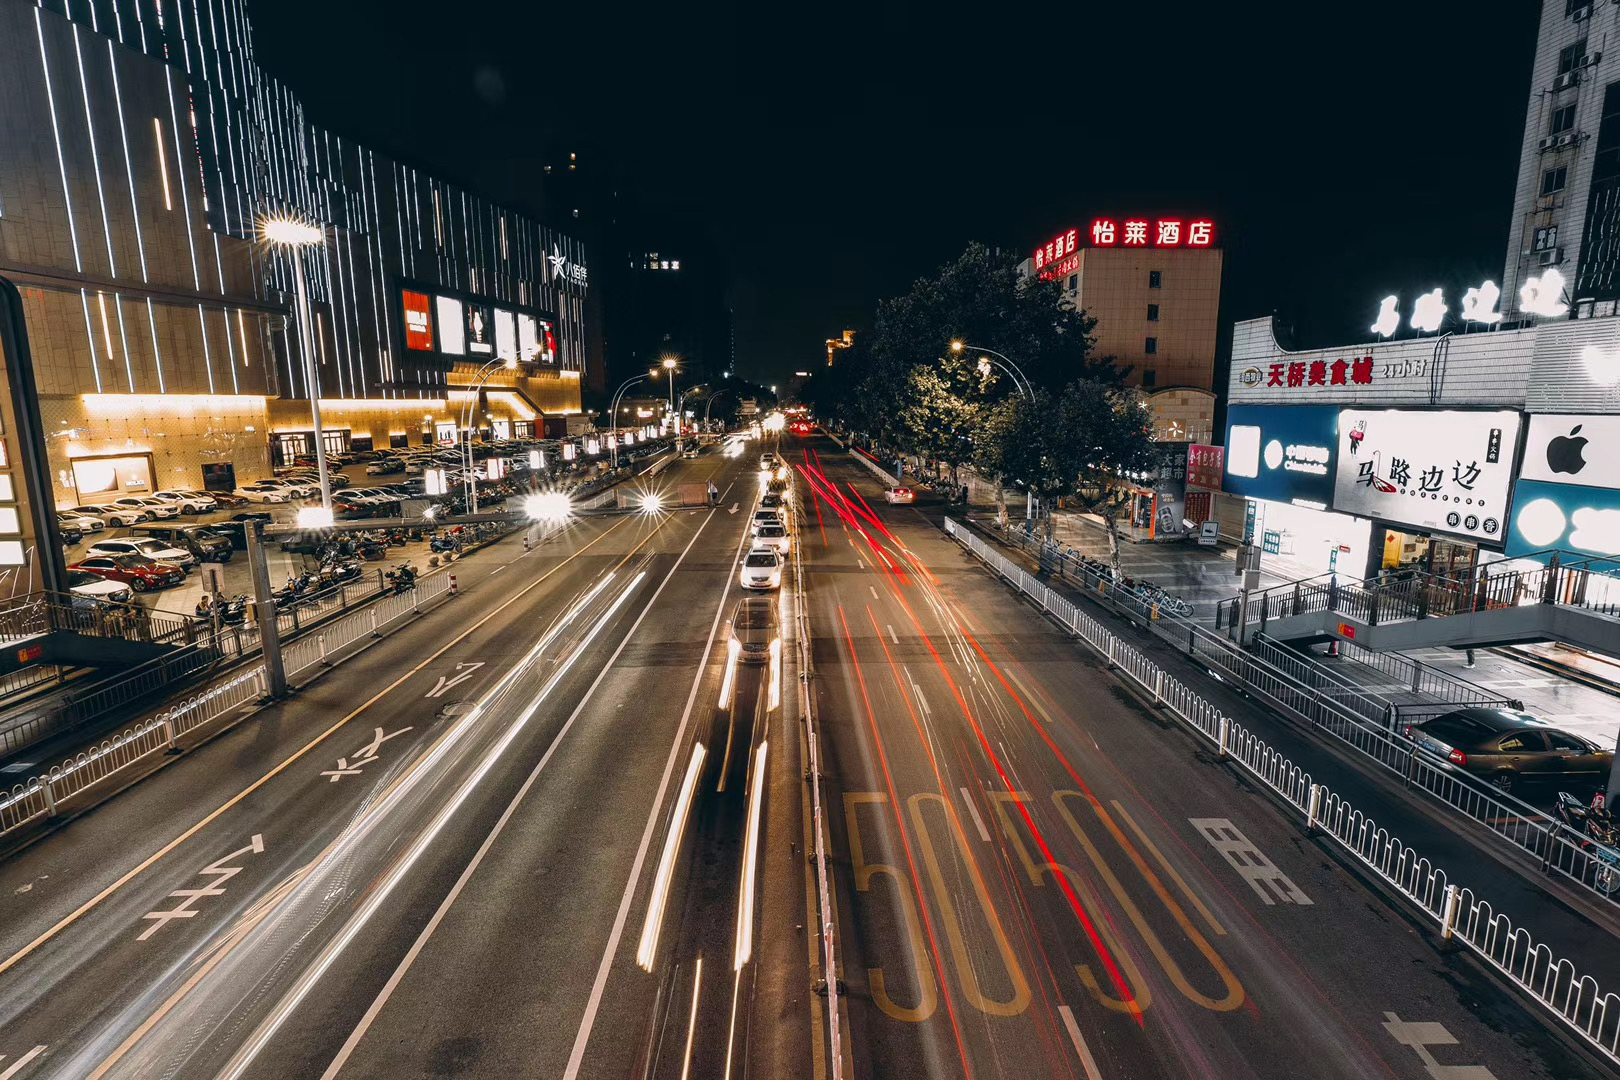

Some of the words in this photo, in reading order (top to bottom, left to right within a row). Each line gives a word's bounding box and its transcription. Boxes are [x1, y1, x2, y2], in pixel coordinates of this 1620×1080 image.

[1093, 221, 1212, 244] 怡莱酒店
[1035, 230, 1076, 269] 怡莱酒店
[566, 262, 587, 281] 八佰伴
[1267, 357, 1374, 387] 天桥美食城
[1382, 360, 1428, 378] 24小时
[1161, 453, 1186, 466] 大家
[1160, 467, 1185, 480] 超市
[1356, 456, 1482, 491] 马路边边
[1447, 512, 1498, 534] 串串香
[842, 791, 1032, 1022] 50
[985, 789, 1247, 1012] 50
